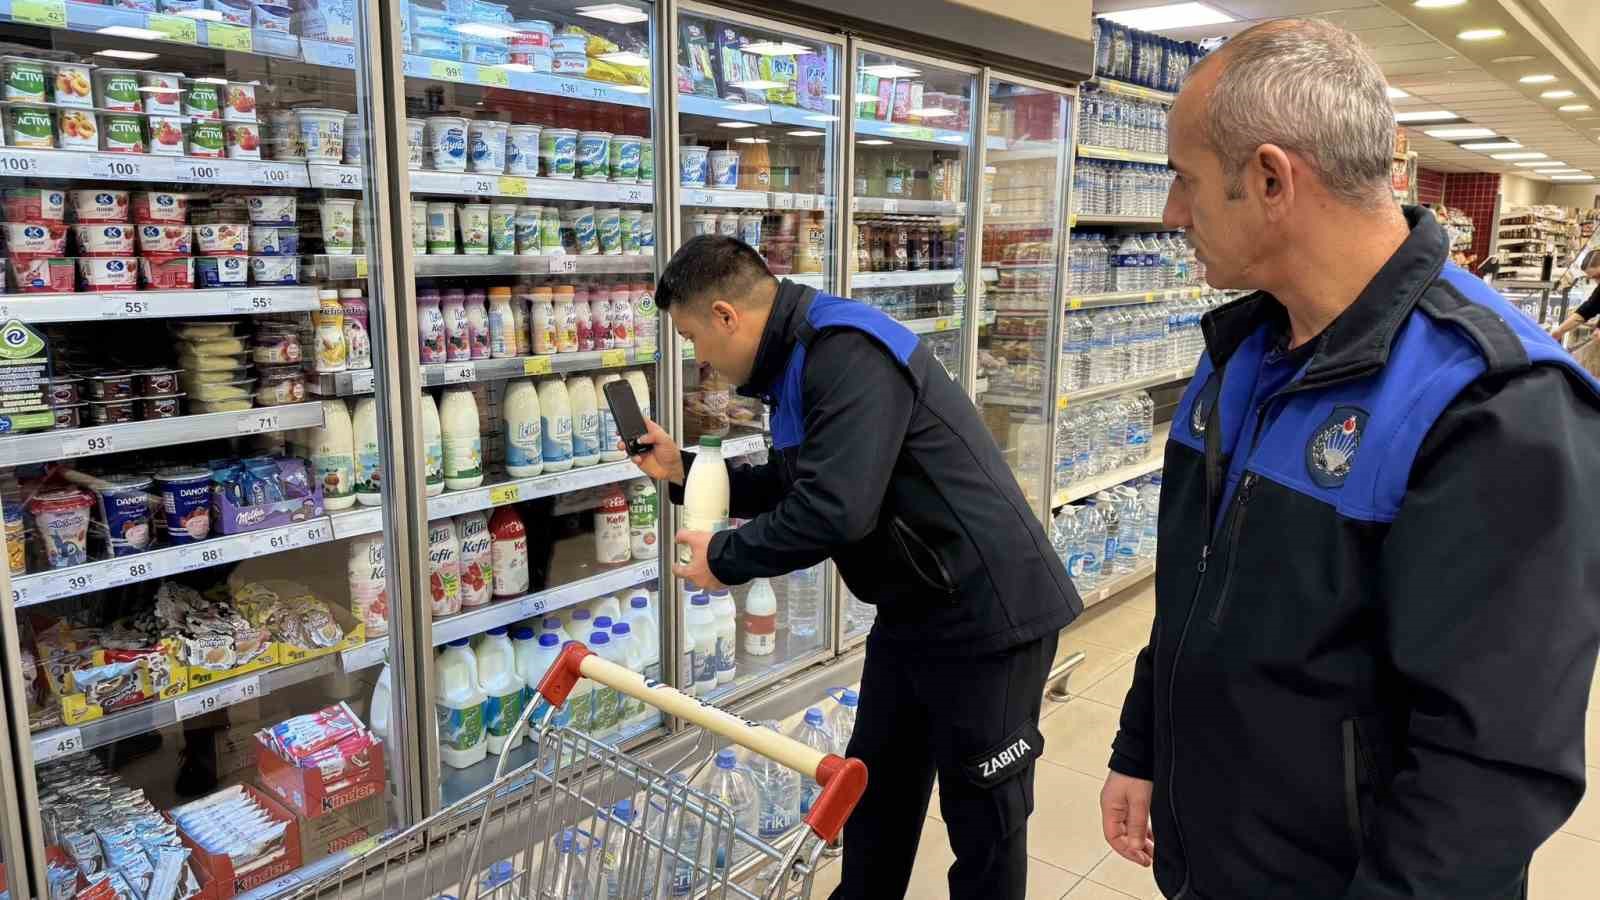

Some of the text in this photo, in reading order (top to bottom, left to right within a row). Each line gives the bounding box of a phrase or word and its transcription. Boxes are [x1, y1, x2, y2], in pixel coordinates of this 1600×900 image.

[1, 158, 29, 171] 100
[108, 162, 133, 176] 100
[191, 167, 213, 178] 100
[125, 302, 142, 312] 55
[253, 297, 267, 308] 55
[460, 369, 471, 378] 43
[88, 438, 105, 450] 93
[235, 506, 265, 525] Milka
[308, 529, 321, 540] 61
[271, 536, 284, 547] 61
[463, 538, 490, 553] Kefir
[202, 550, 217, 562] 88
[429, 549, 453, 563] efir
[130, 564, 146, 577] 88
[68, 576, 85, 589] 39
[200, 696, 214, 709] 19
[57, 739, 74, 752] 45
[978, 738, 1032, 778] ZABITA
